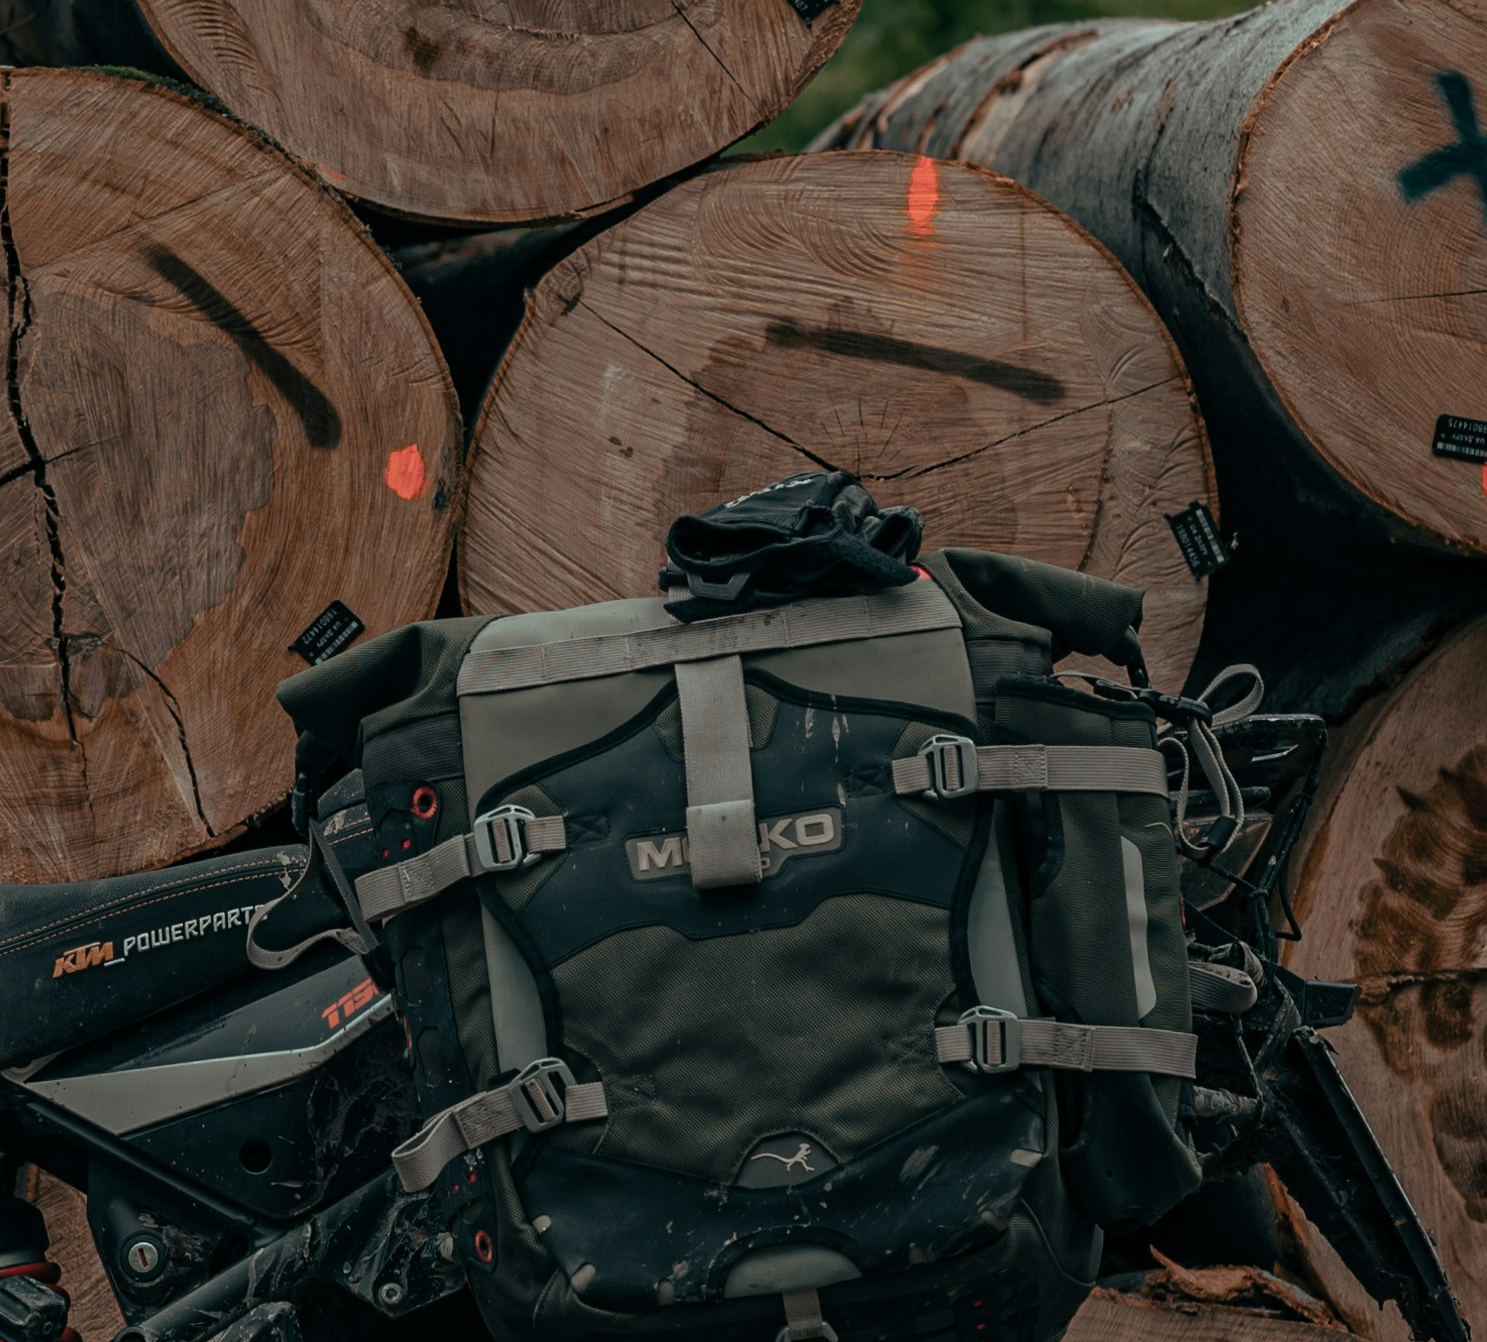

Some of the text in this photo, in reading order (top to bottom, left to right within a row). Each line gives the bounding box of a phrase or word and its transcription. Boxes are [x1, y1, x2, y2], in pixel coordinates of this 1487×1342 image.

[299, 607, 338, 645] 198014472
[635, 812, 835, 874] MKO
[321, 977, 381, 1030] 119
